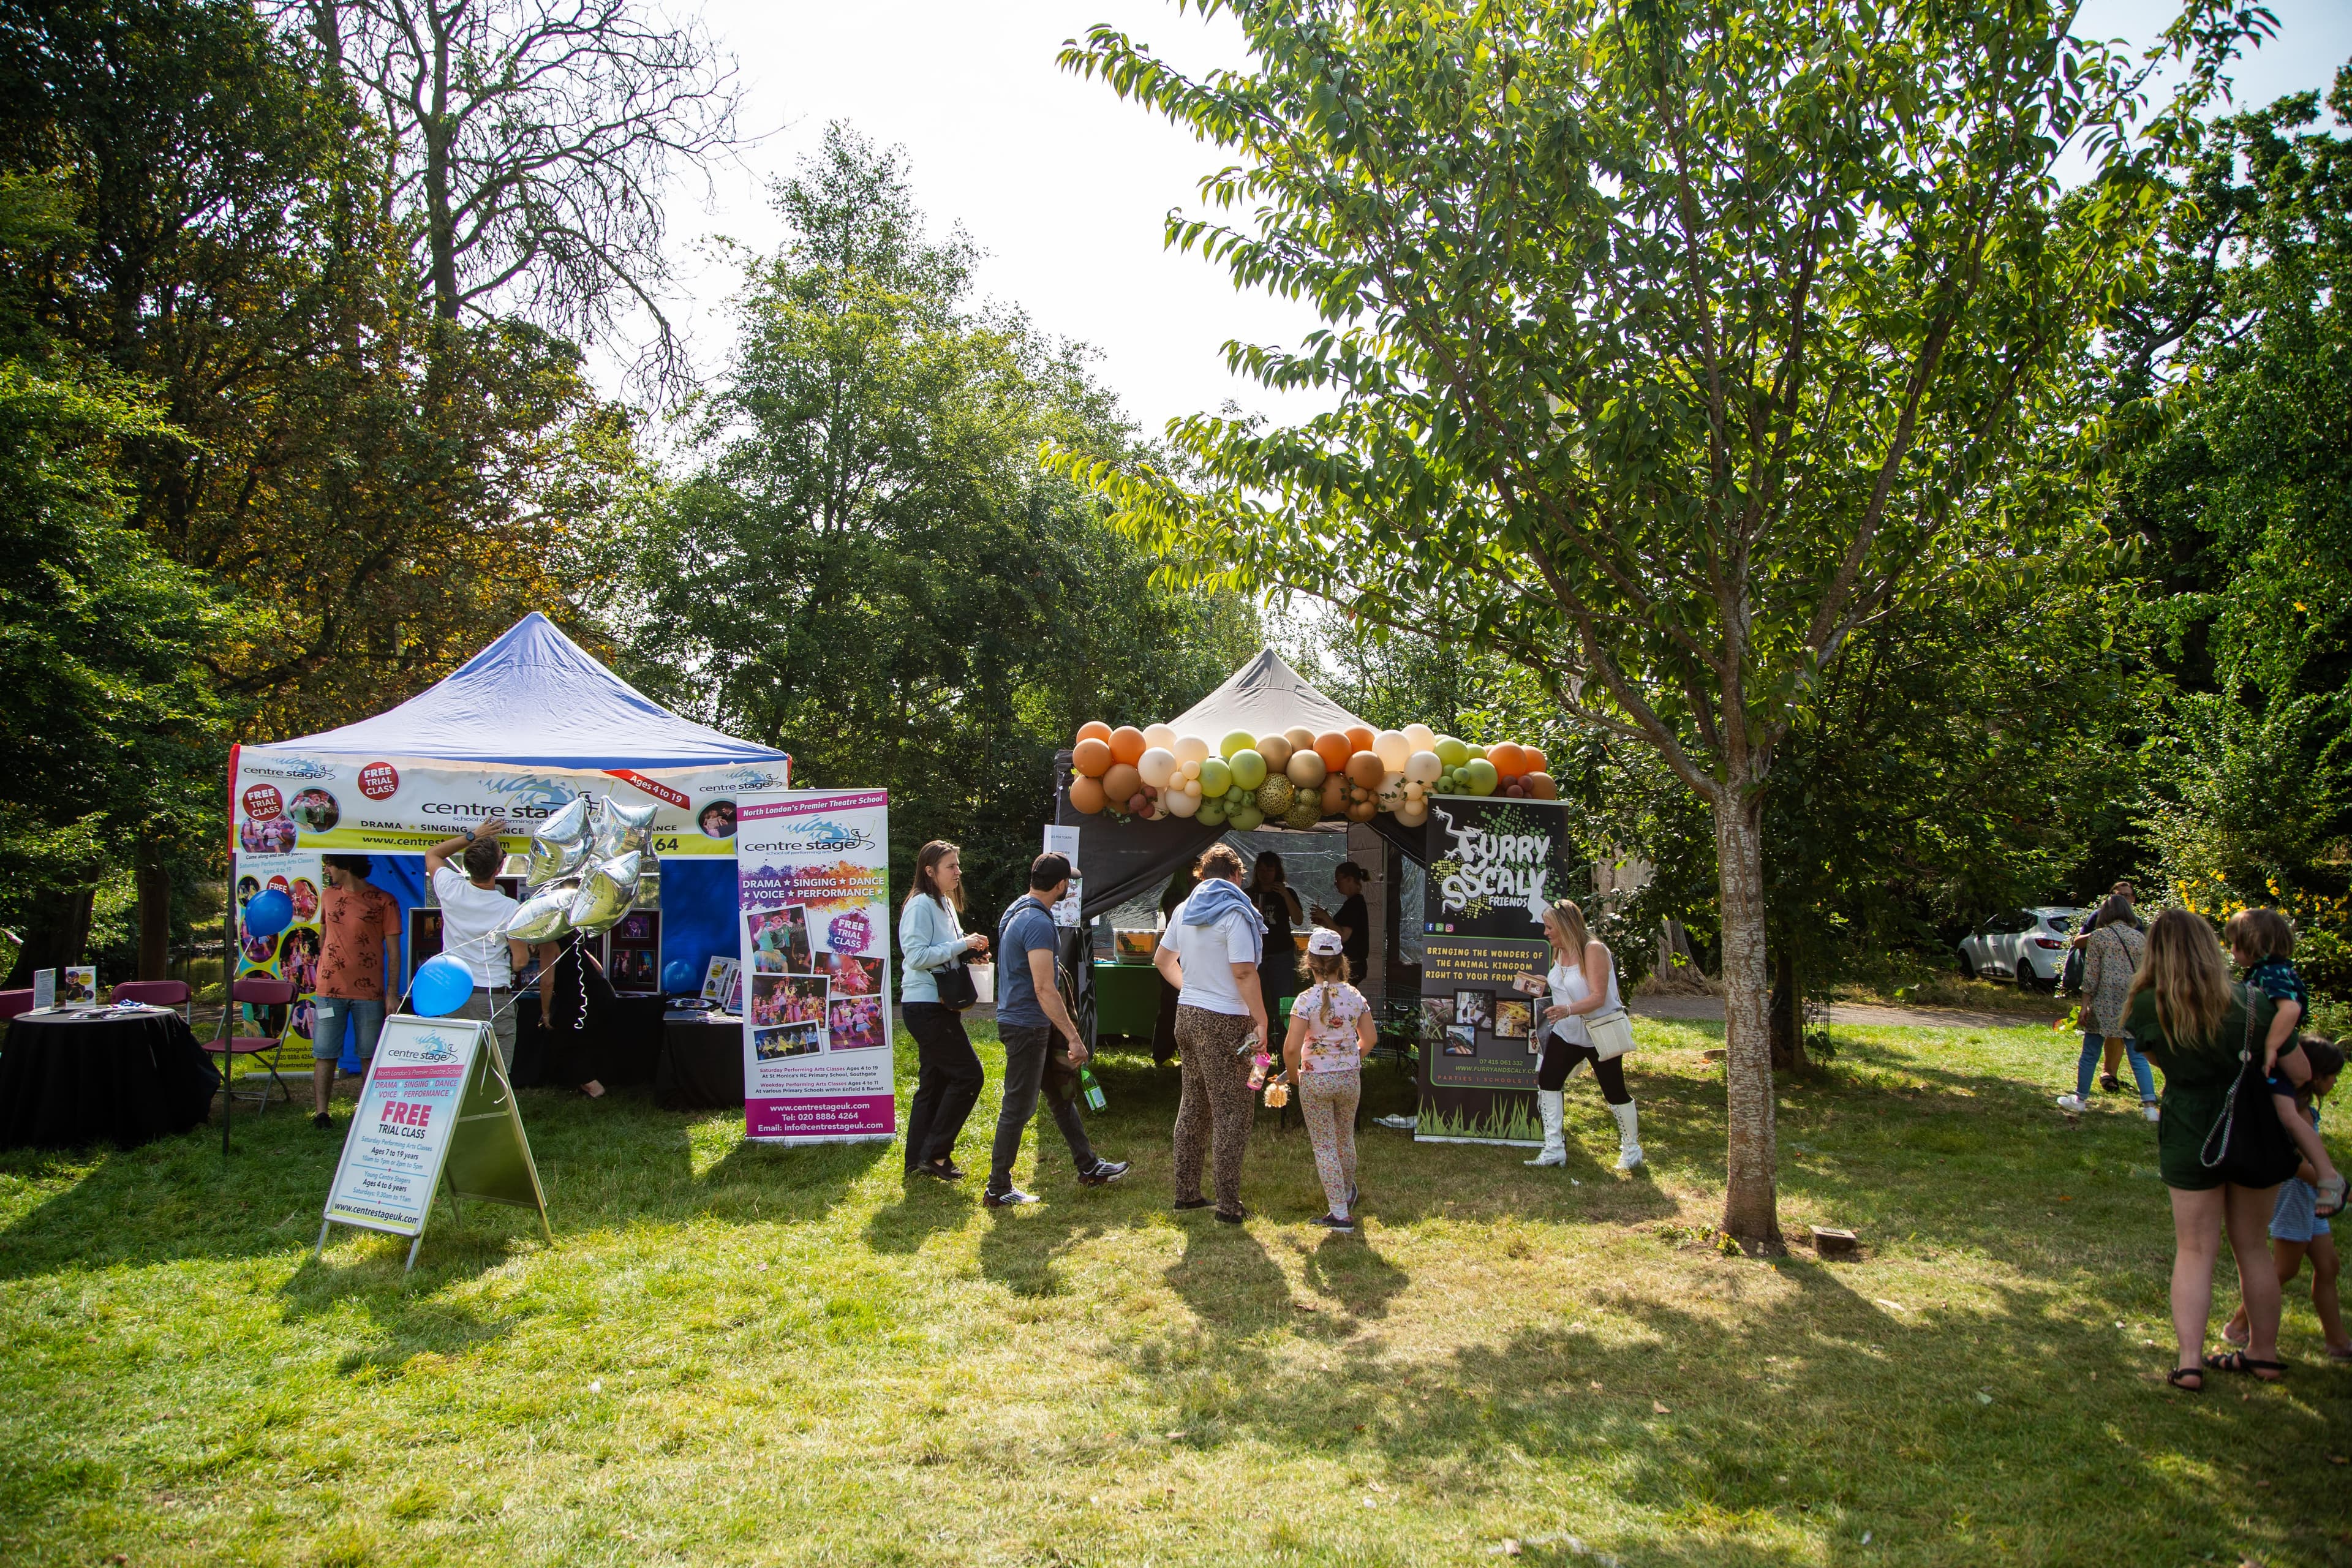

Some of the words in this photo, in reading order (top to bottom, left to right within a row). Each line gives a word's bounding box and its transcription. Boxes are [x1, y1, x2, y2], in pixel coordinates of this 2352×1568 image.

[287, 769, 322, 780] stage
[364, 766, 392, 778] FREE
[365, 777, 393, 786] TRIAL
[247, 788, 276, 801] FREE
[366, 785, 395, 795] CLASS
[630, 775, 652, 790] Ages
[659, 788, 669, 798] to
[671, 793, 682, 803] 19
[250, 798, 276, 809] TRIAL
[743, 808, 764, 817] North
[766, 804, 798, 815] London's
[799, 801, 828, 810] Premier
[829, 799, 857, 808] Theatre
[858, 795, 883, 804] School
[252, 806, 281, 817] CLASS
[422, 803, 505, 817] centre
[511, 805, 560, 818] sta
[361, 821, 402, 829] DRAMA
[421, 824, 468, 833] SINGING
[745, 842, 802, 851] centre
[806, 841, 856, 852] stage
[793, 878, 837, 887] SINGING
[849, 877, 884, 886] DANCE
[269, 882, 287, 894] FREE
[753, 890, 785, 899] VOICE
[797, 888, 875, 898] PERFORMANCE
[1488, 896, 1528, 907] FRIENDS
[838, 918, 865, 932] FREE
[837, 929, 862, 940] TRIAL
[833, 937, 862, 948] CLASS
[1427, 947, 1470, 957] BRINGING
[1491, 950, 1529, 959] WONDERS
[1532, 951, 1544, 960] OF
[1454, 960, 1490, 969] ANIMAL
[1493, 962, 1532, 971] KINGDOM
[388, 1049, 419, 1058] centre
[420, 1052, 447, 1063] stage
[769, 1102, 870, 1112] www.centrestageuk.com
[381, 1100, 432, 1127] FREE
[379, 1124, 399, 1136] TRIAL
[401, 1127, 426, 1139] CLASS
[784, 1121, 883, 1131] info@centrestageuk.com
[361, 1136, 381, 1145] Saturday
[381, 1139, 405, 1149] Performing
[371, 1147, 385, 1156] Ages
[363, 1178, 376, 1188] Ages
[364, 1170, 379, 1180] Young
[394, 1176, 411, 1185] Stagers
[353, 1187, 375, 1197] Saturdays:
[377, 1190, 393, 1199] 9.30am
